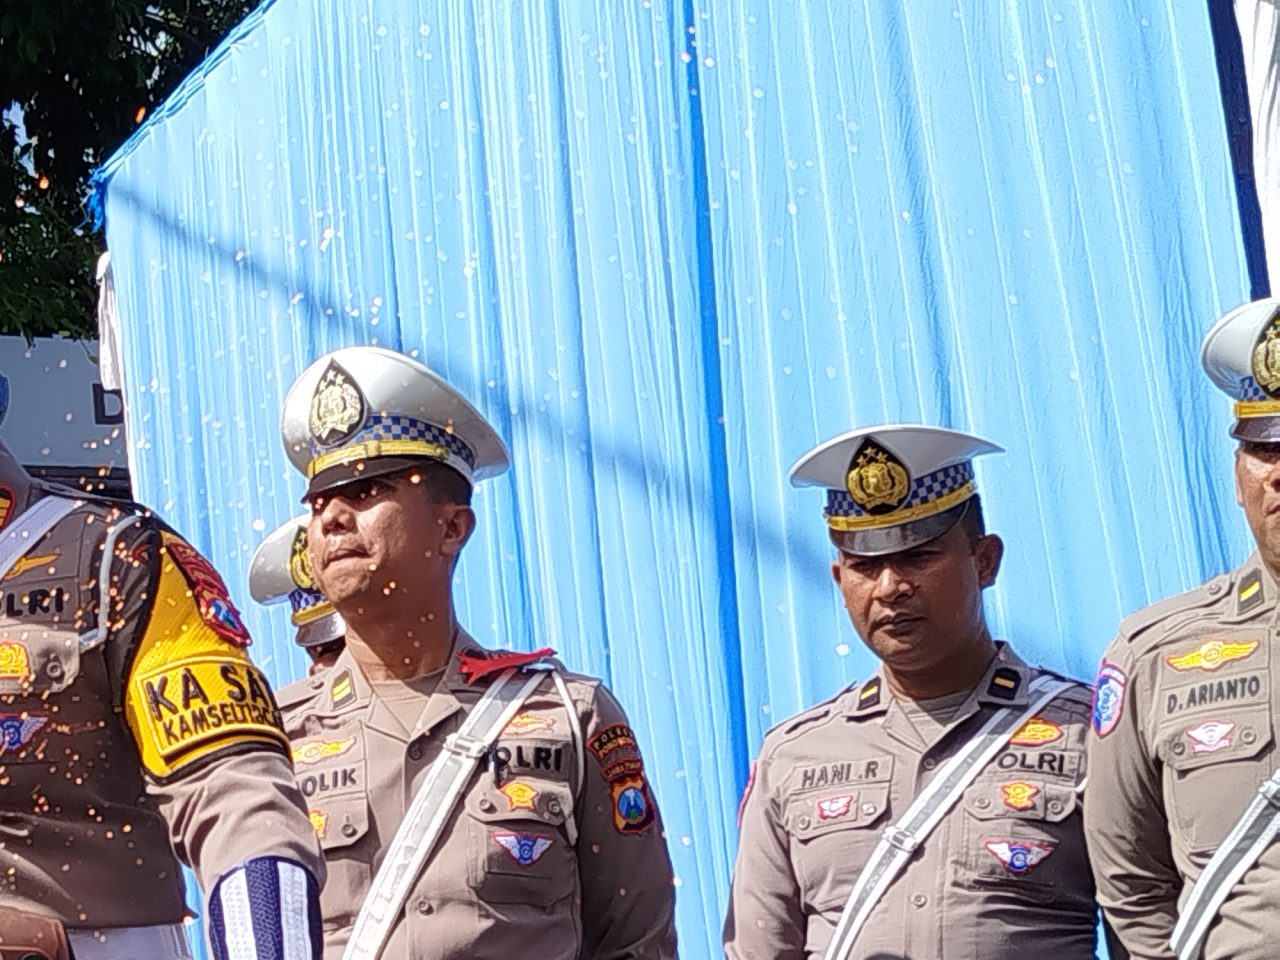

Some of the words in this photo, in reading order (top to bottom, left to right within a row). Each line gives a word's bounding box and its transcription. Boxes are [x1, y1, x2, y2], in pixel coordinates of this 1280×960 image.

[145, 667, 210, 721] KA
[220, 662, 277, 709] SA
[496, 745, 562, 771] OLRI
[997, 751, 1065, 774] OLRI
[301, 768, 357, 798] OLIK
[801, 763, 852, 788] HANI
